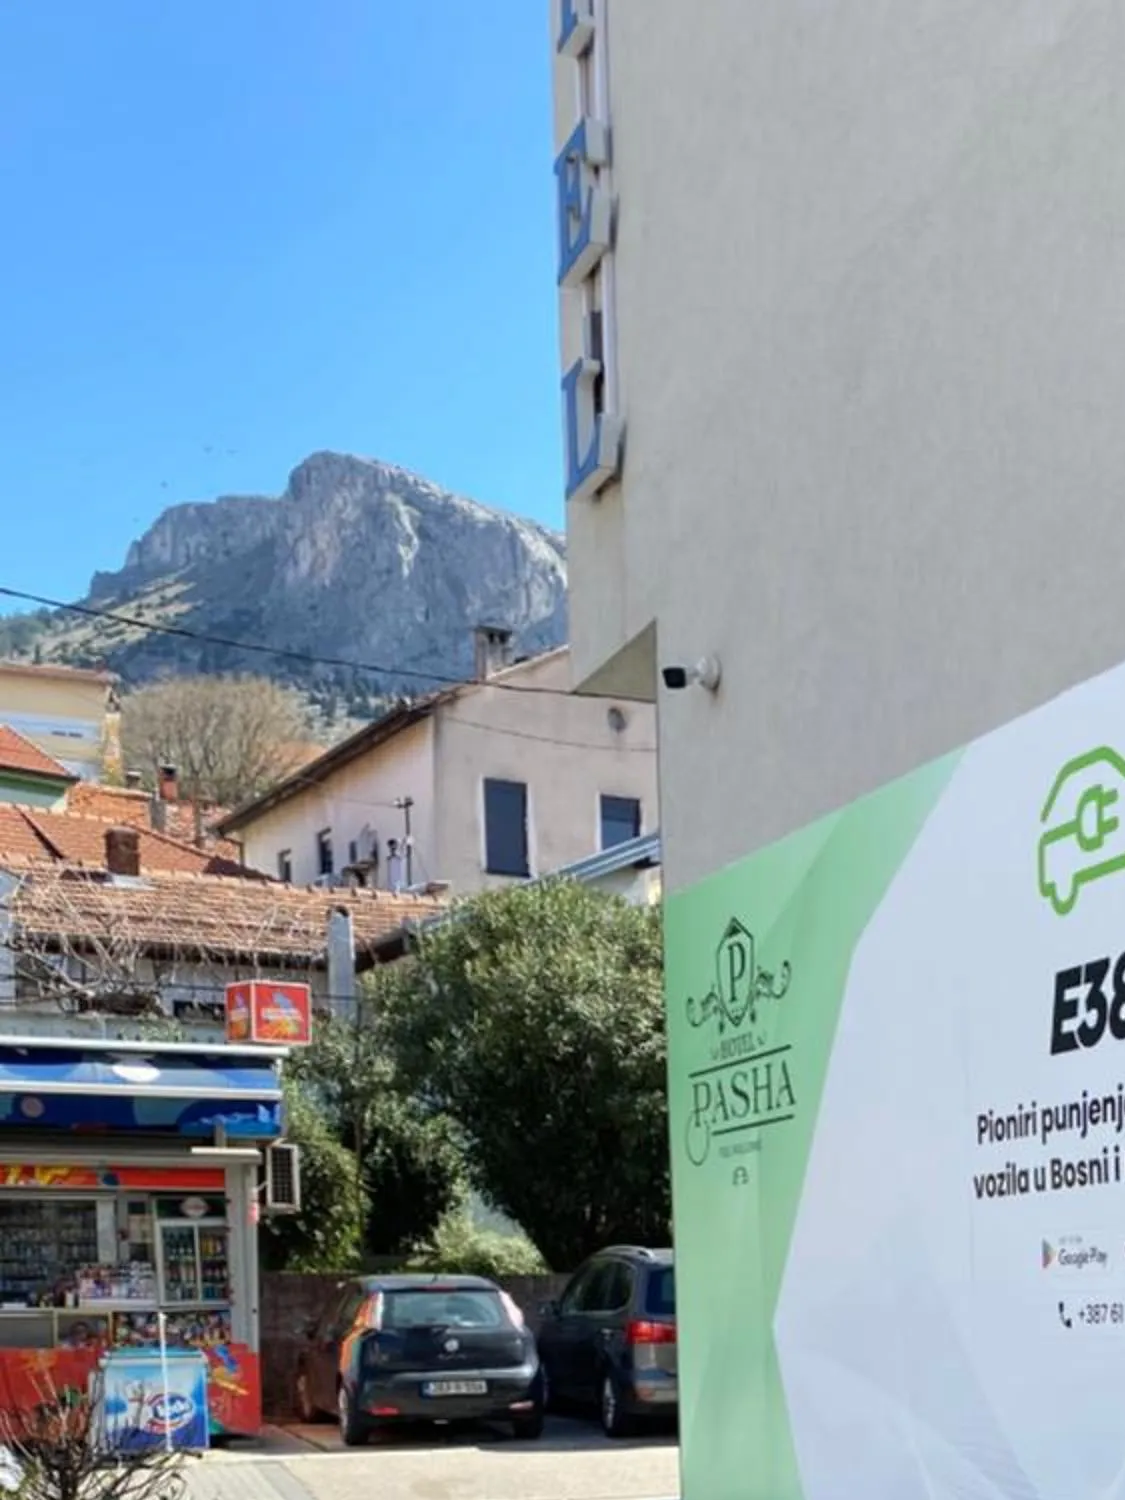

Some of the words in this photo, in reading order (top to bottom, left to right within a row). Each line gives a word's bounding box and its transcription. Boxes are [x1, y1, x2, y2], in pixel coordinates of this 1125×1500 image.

[692, 1059, 796, 1128] PASHA
[977, 1101, 1037, 1145] Pioniri
[973, 1162, 1030, 1199] vozila
[1034, 1167, 1046, 1192] u
[1051, 1146, 1109, 1190] Bosni
[1114, 1144, 1121, 1182] i
[1058, 1248, 1089, 1269] Google
[1078, 1303, 1109, 1325] +387
[1110, 1302, 1124, 1324] 61
